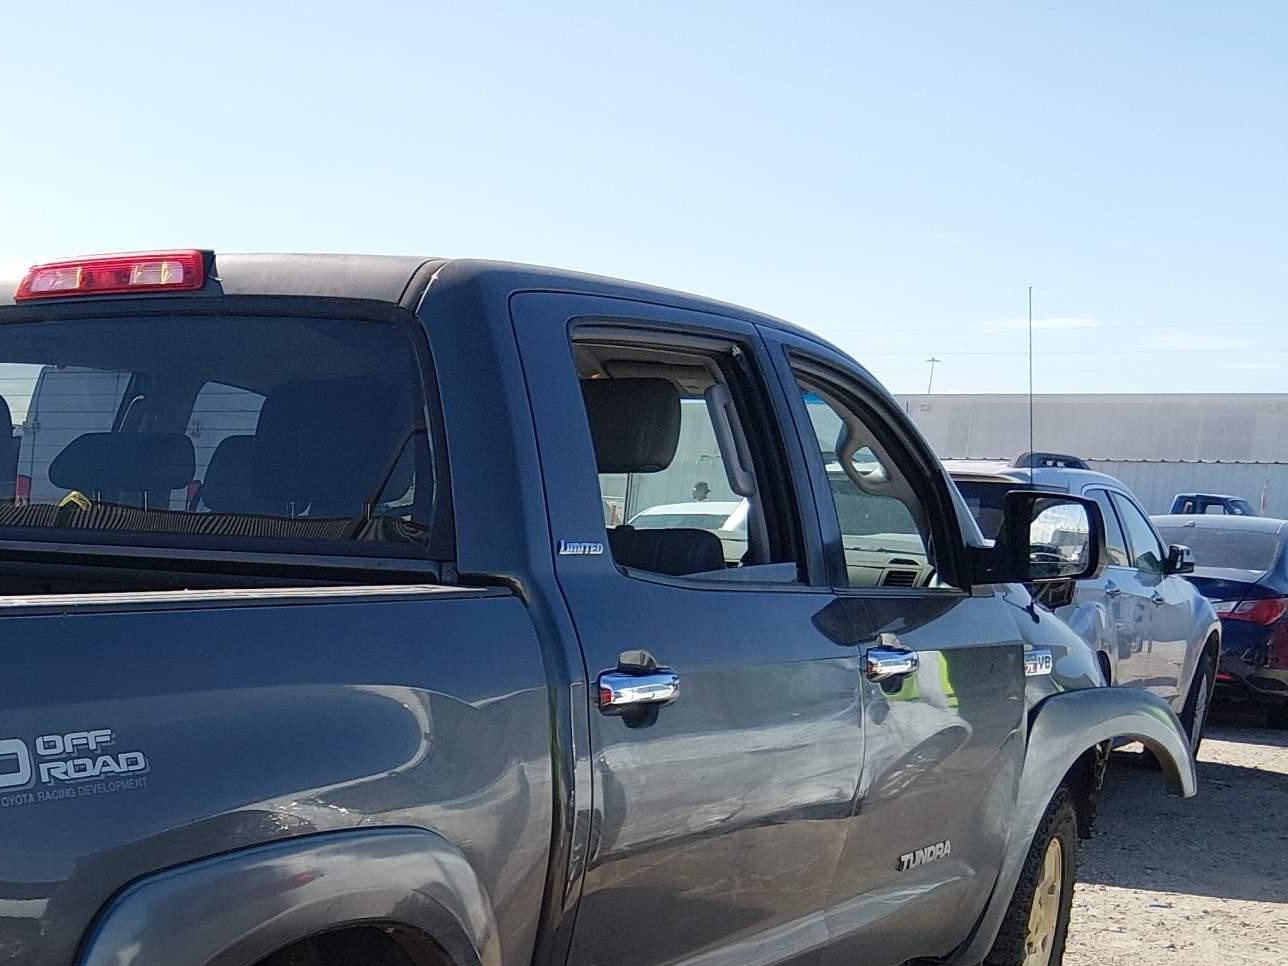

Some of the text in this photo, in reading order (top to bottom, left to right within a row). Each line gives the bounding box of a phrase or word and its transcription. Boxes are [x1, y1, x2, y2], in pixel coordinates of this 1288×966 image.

[34, 728, 115, 757] OFF
[38, 751, 149, 786] ROAD
[38, 787, 76, 802] RACING
[79, 777, 148, 797] DEVELOPMENT
[899, 840, 952, 872] TUNDRA
